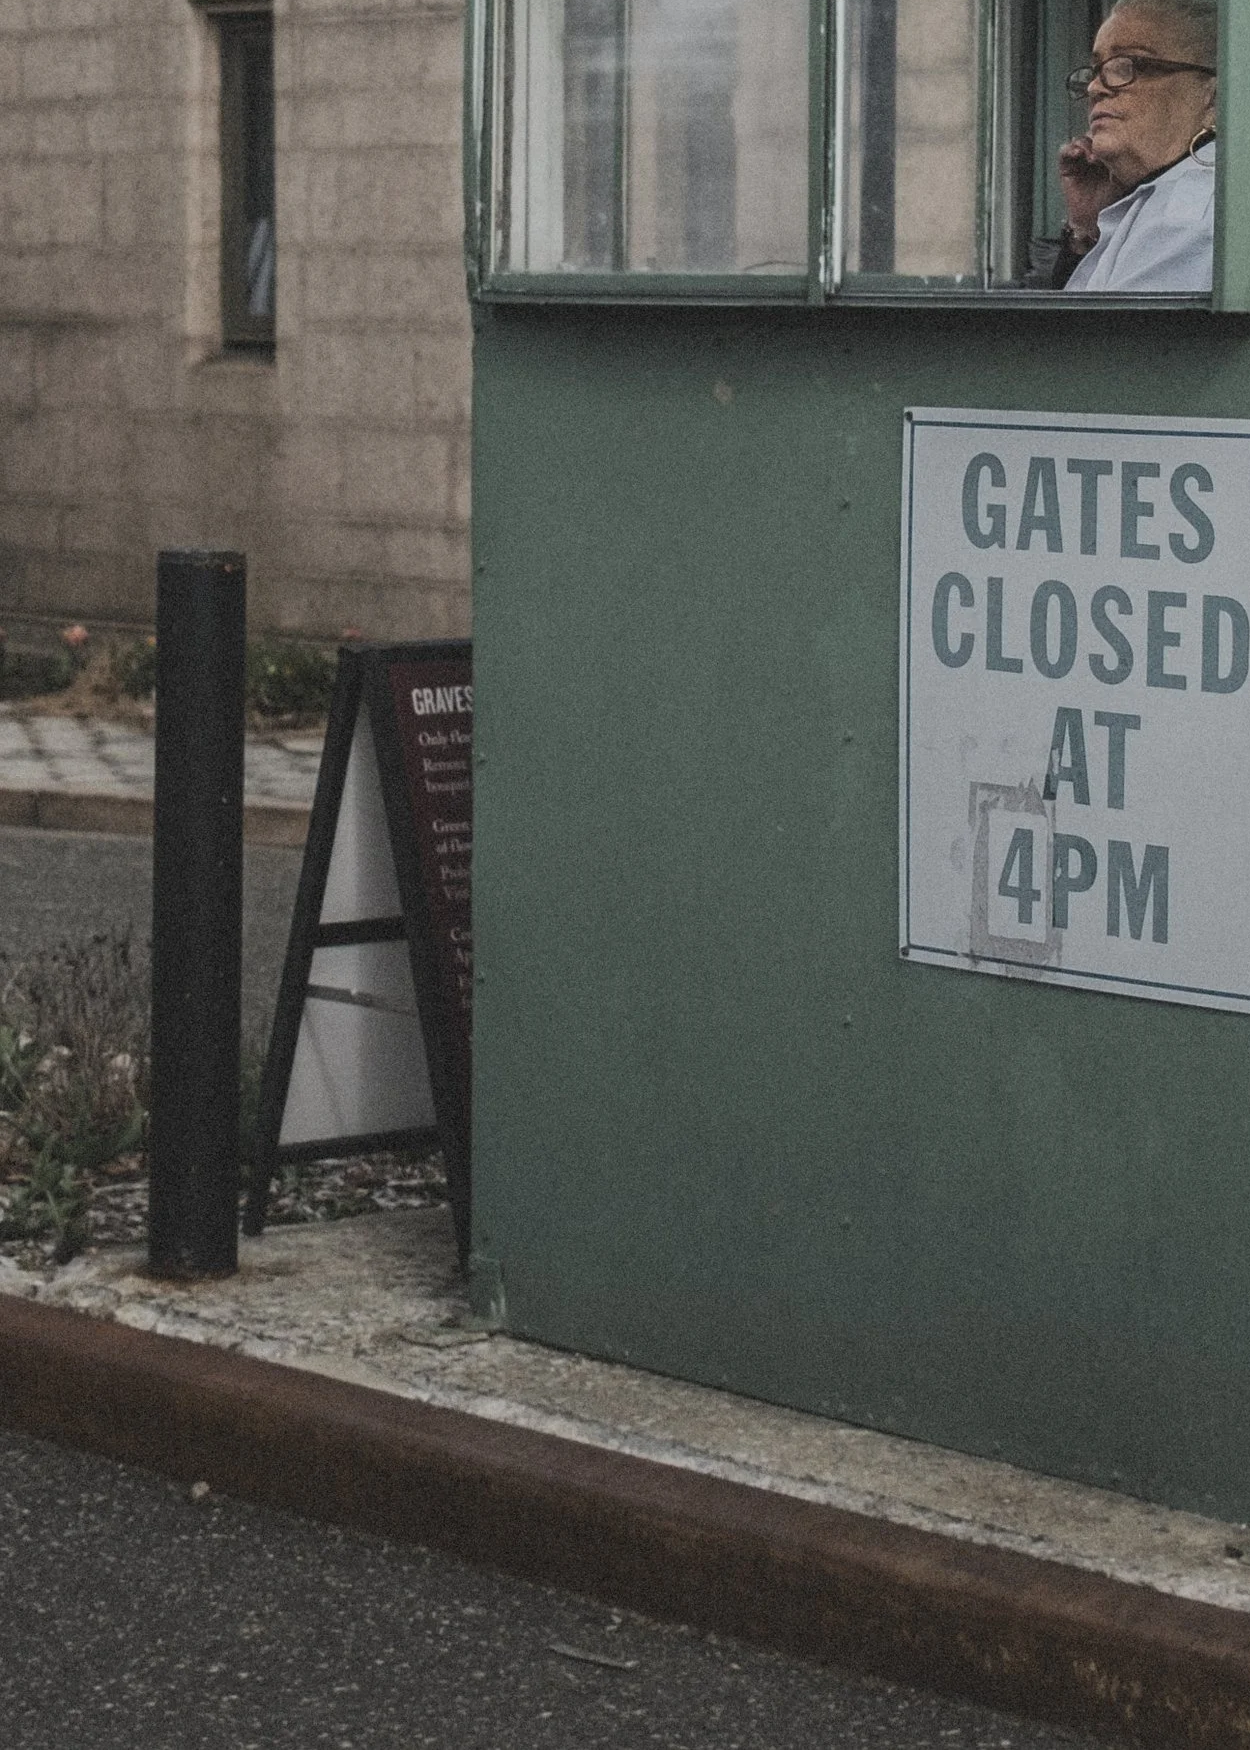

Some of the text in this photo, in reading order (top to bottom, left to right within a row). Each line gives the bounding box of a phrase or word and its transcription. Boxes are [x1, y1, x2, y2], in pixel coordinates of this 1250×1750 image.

[962, 452, 1215, 564] GATES
[931, 572, 1250, 694] CLOSED
[1042, 707, 1141, 811] AT
[998, 828, 1170, 945] 4PM
